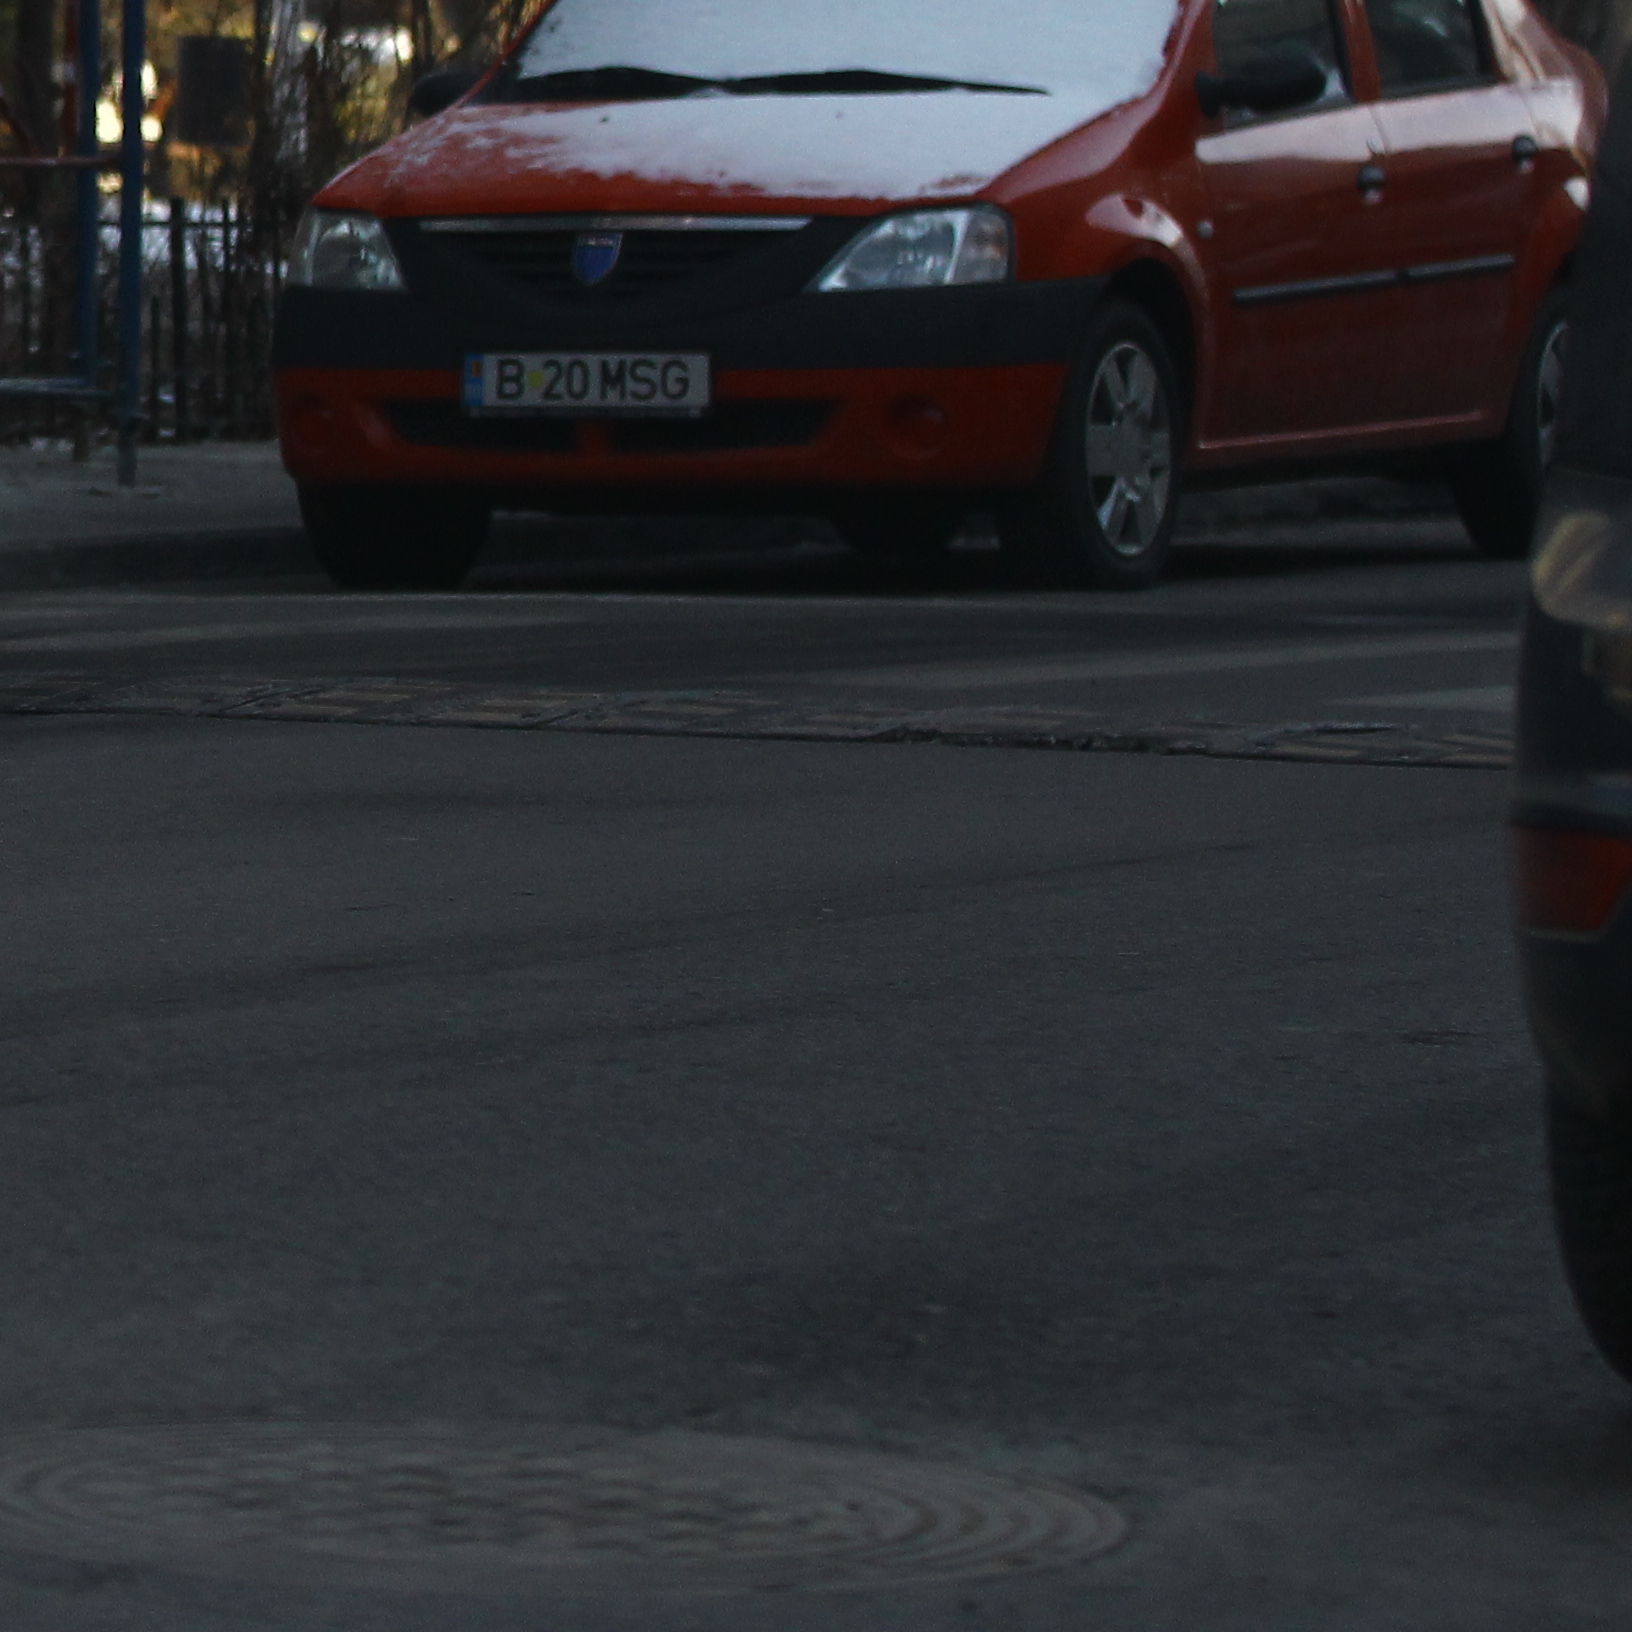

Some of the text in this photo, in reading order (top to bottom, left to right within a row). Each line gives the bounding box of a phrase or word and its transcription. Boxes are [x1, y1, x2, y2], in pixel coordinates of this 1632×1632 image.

[498, 359, 523, 399] B
[541, 358, 590, 401] 20
[599, 359, 691, 401] MSG
